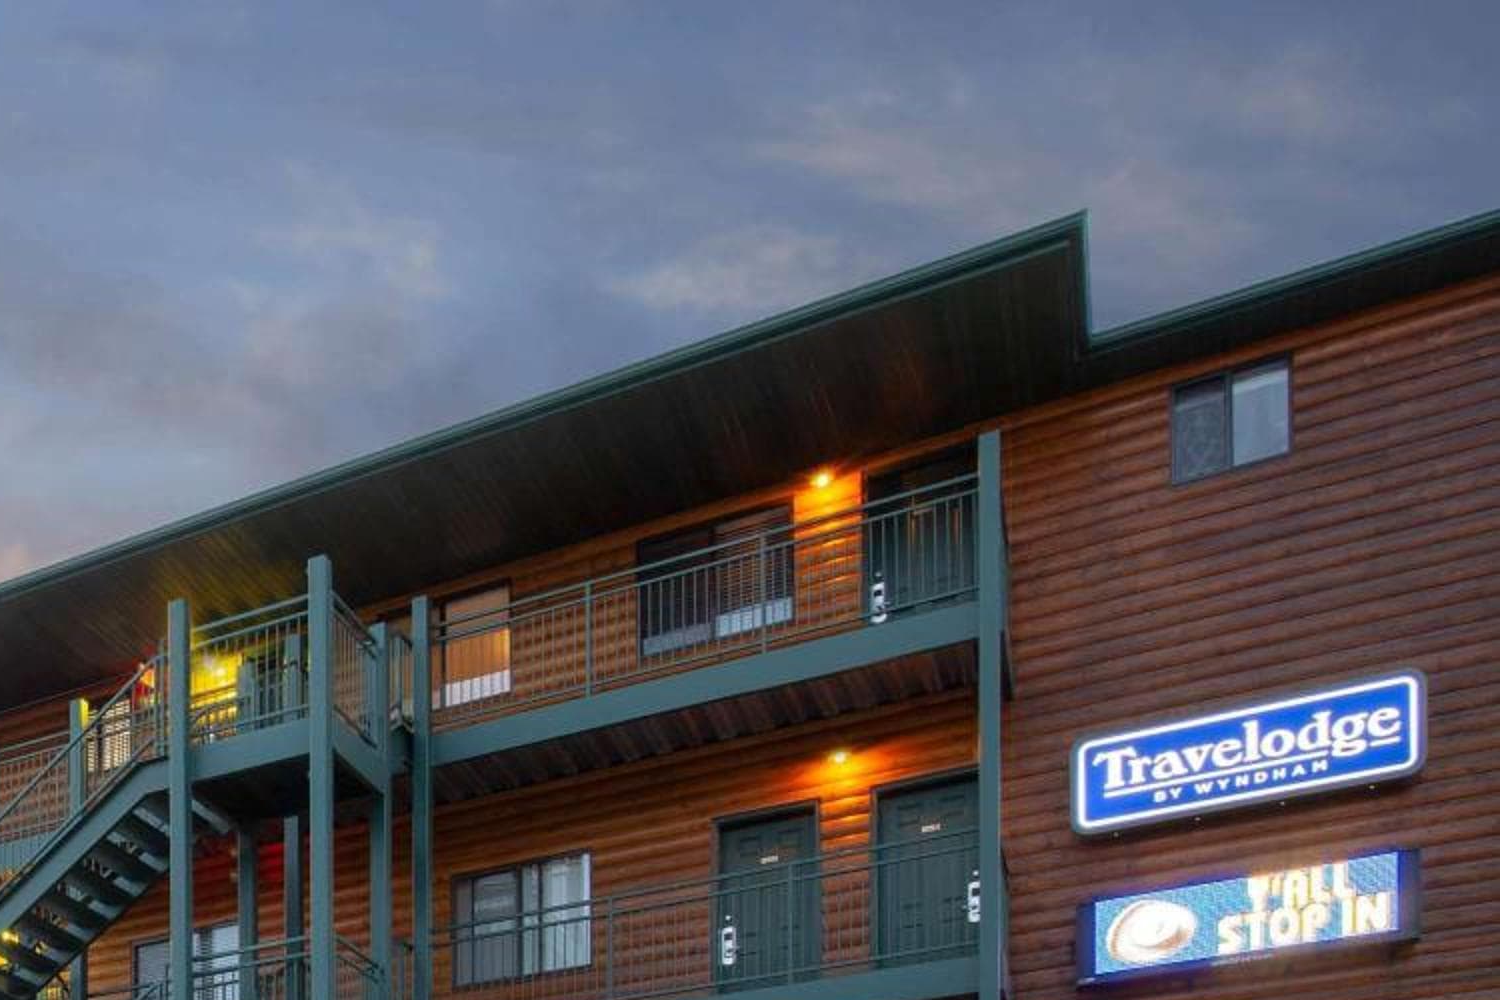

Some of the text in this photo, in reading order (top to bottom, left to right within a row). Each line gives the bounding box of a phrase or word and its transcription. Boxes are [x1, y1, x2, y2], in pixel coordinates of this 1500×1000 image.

[1092, 706, 1402, 790] Travelodge
[1153, 758, 1329, 803] BY WYNDHAM
[1217, 891, 1391, 955] STOP IN
